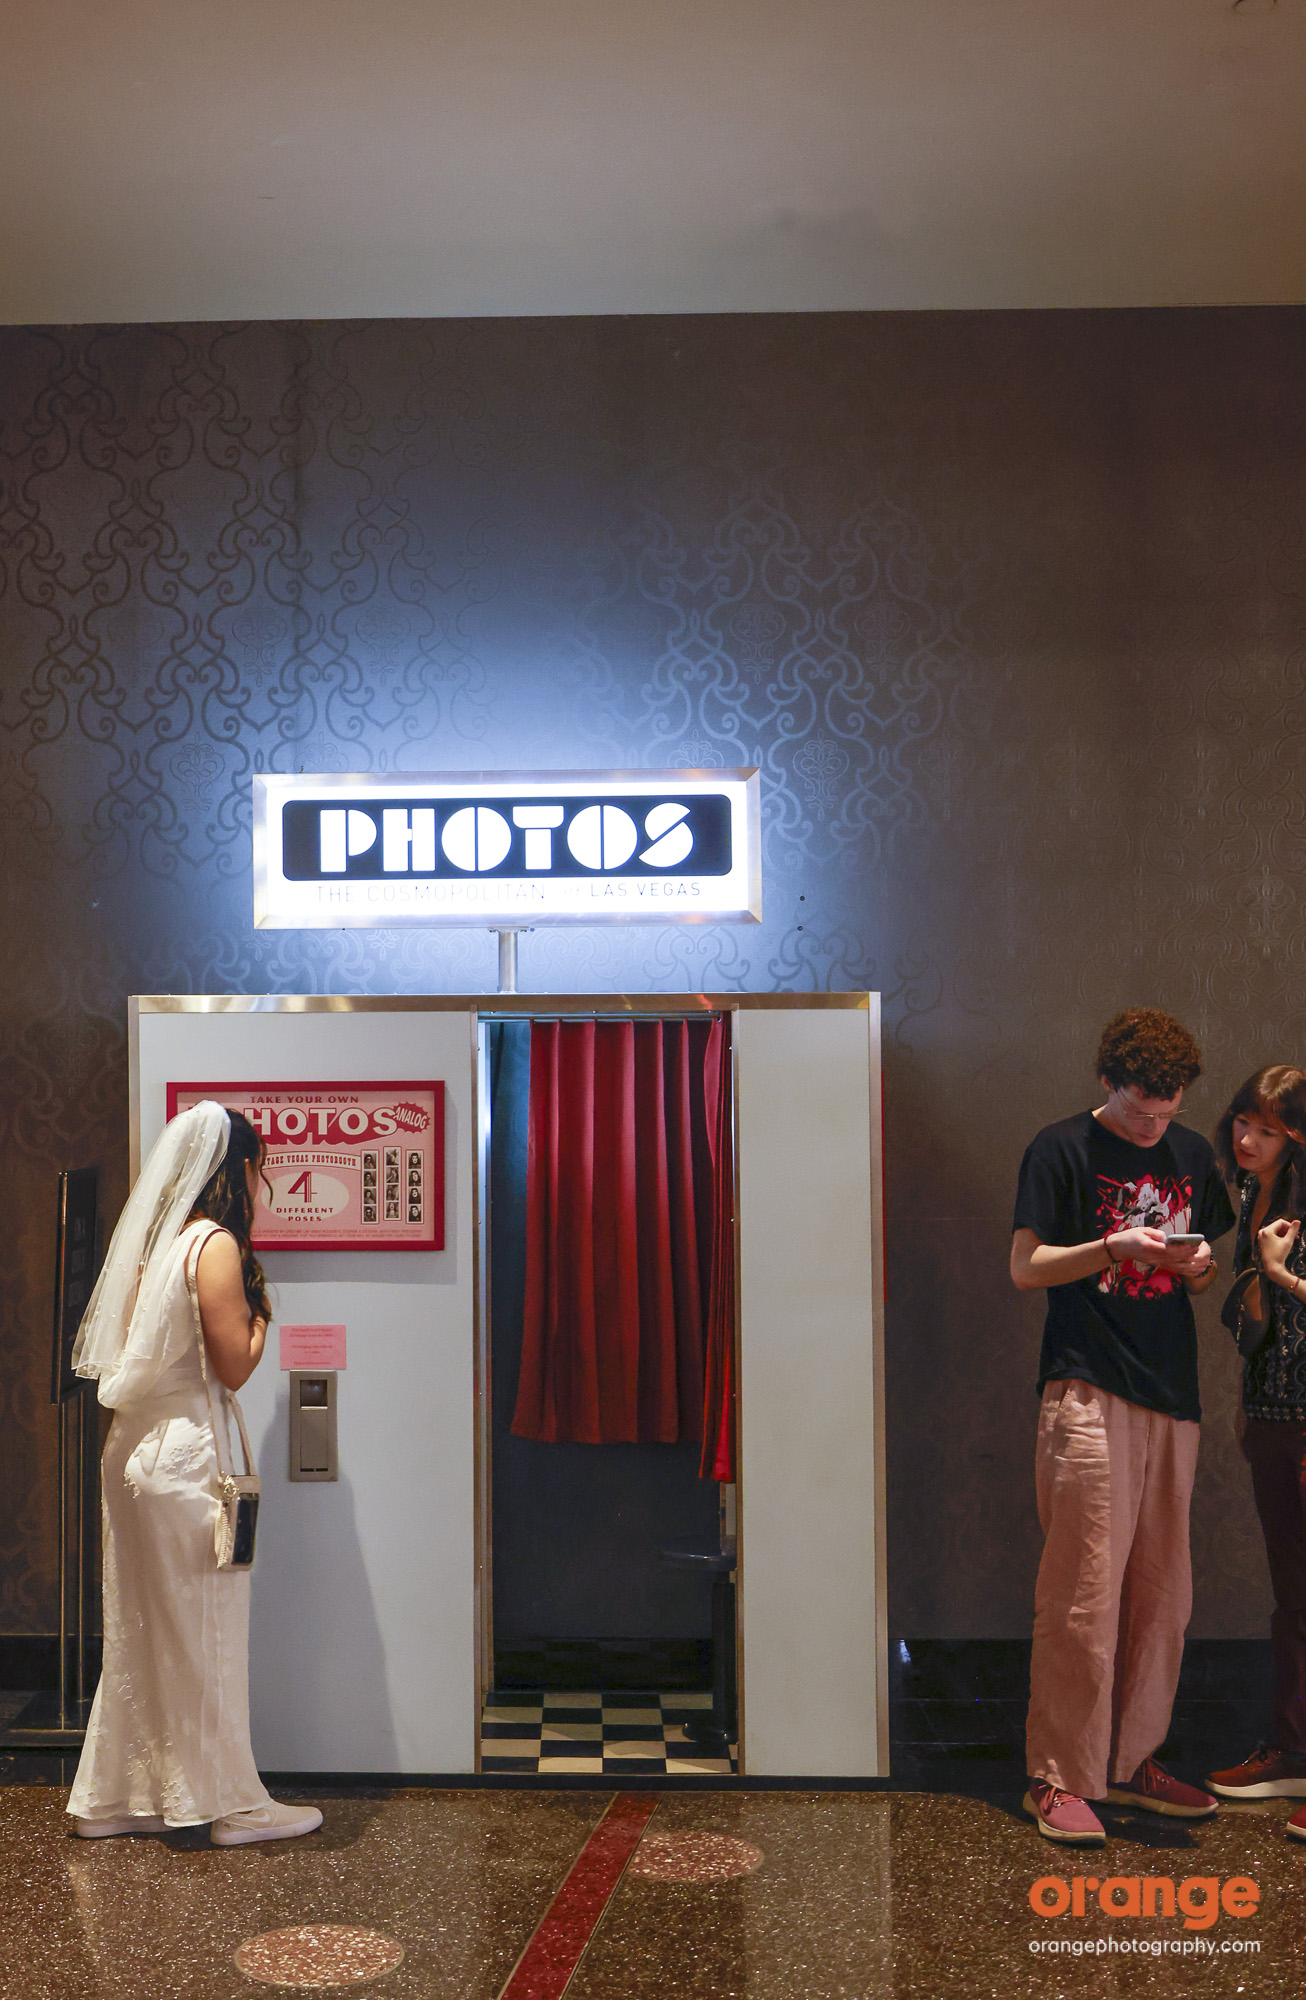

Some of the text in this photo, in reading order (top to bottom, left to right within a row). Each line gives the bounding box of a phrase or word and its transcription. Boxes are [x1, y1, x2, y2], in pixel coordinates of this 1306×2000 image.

[319, 801, 695, 873] PHOTOS
[315, 884, 355, 903] THE
[366, 882, 545, 902] COSMOPOLITAN
[590, 882, 628, 897] LAS
[636, 881, 701, 897] VEGAS
[250, 1095, 360, 1104] TAKE YOUR OWN
[244, 1107, 399, 1136] HOTOS
[392, 1106, 428, 1129] ANALOG
[263, 1154, 357, 1167] TAGE VEGAS PHOTOBOOTH
[287, 1171, 318, 1204] 4
